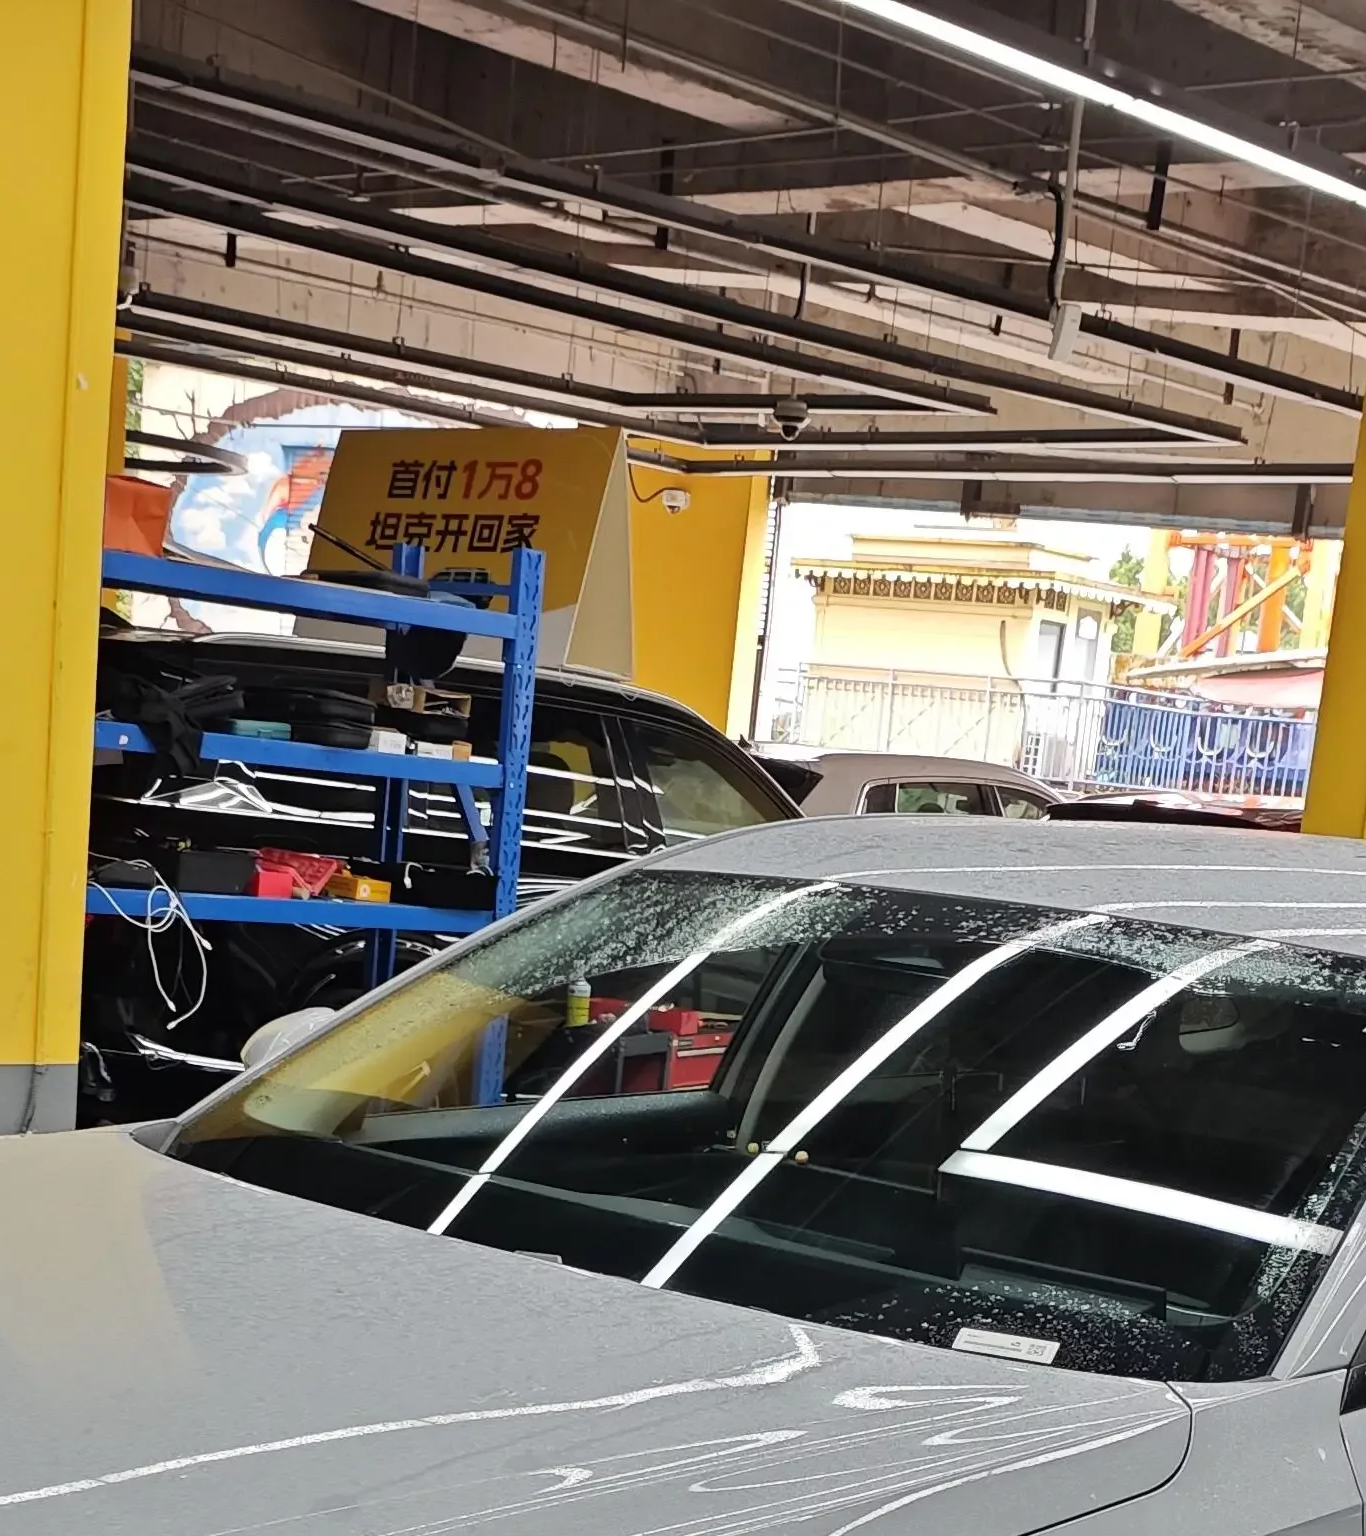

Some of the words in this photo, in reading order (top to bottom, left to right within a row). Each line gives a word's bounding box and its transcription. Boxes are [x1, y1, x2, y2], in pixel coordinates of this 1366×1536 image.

[387, 458, 543, 500] 首付1万8
[365, 511, 541, 554] 坦克开回家
